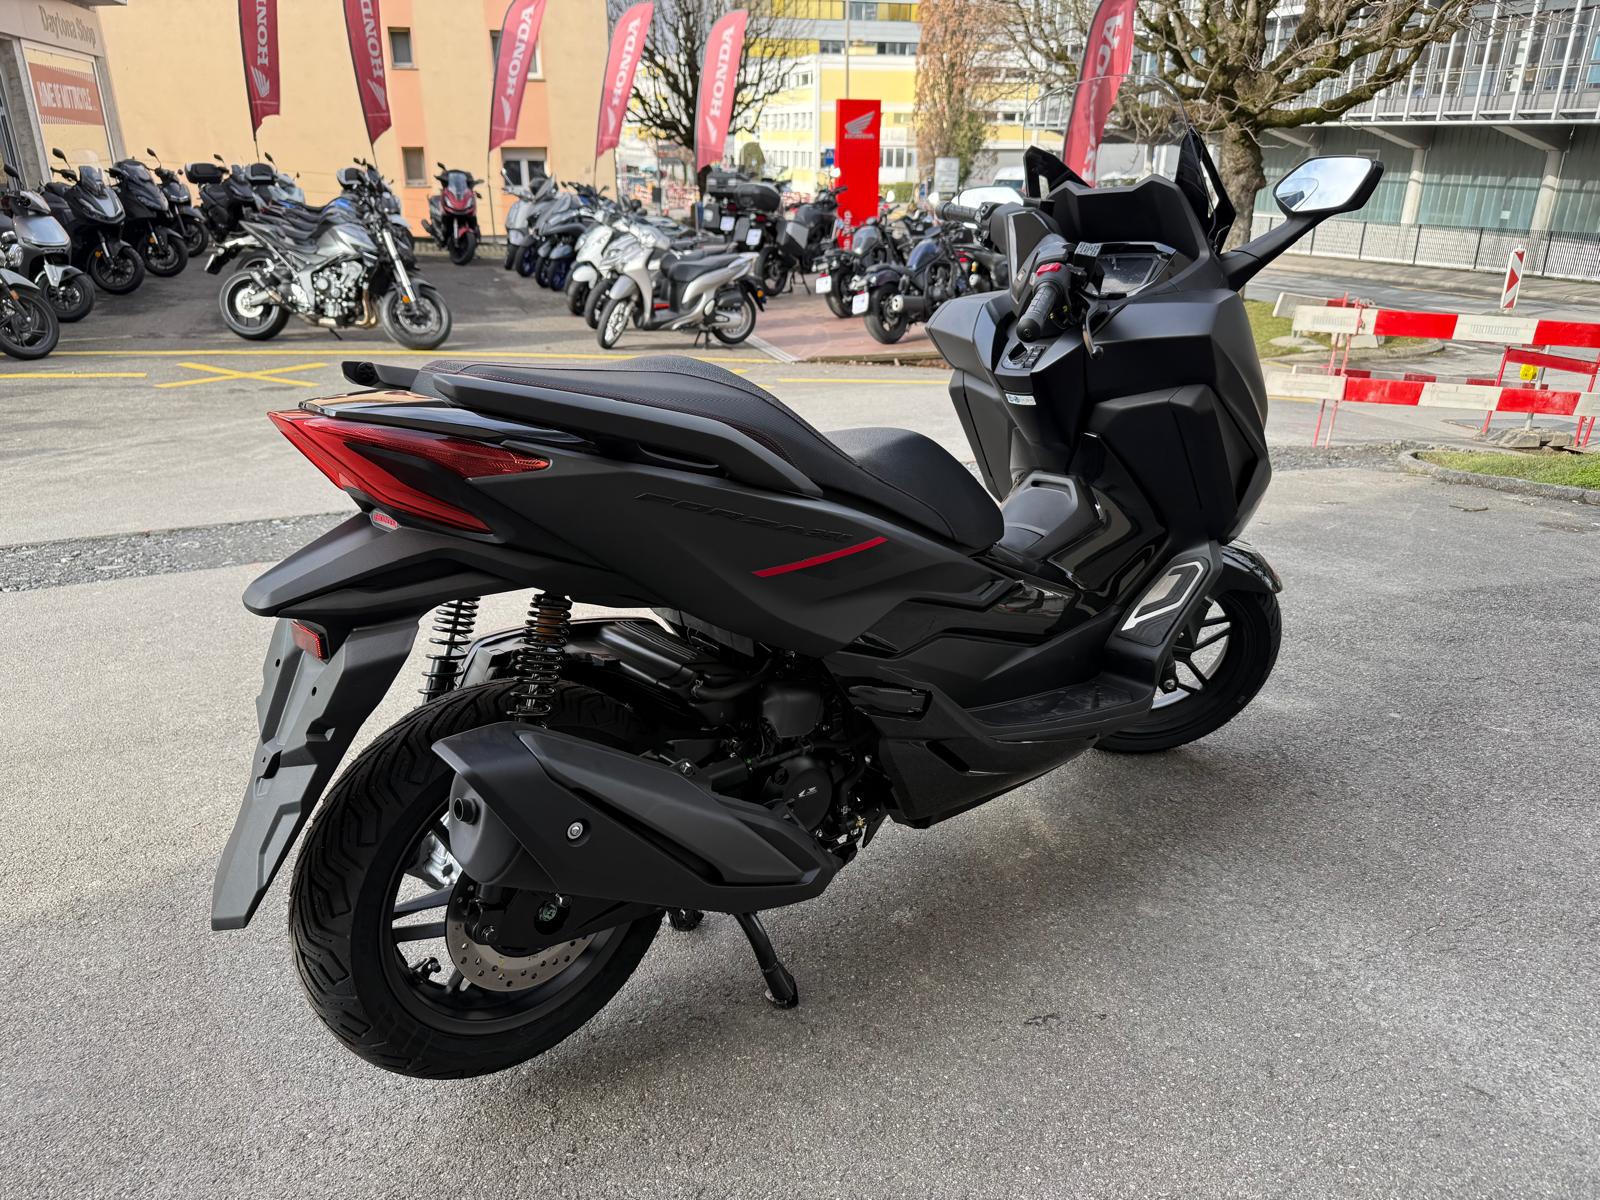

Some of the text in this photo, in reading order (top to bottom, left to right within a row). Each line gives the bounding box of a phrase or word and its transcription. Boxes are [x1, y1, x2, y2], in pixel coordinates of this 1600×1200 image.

[38, 4, 96, 48] Daytona Shop
[256, 0, 269, 66] HON
[506, 4, 535, 96] HONDA
[611, 17, 641, 107] HONDA
[709, 25, 735, 118] HONDA
[1081, 11, 1125, 182] HDA
